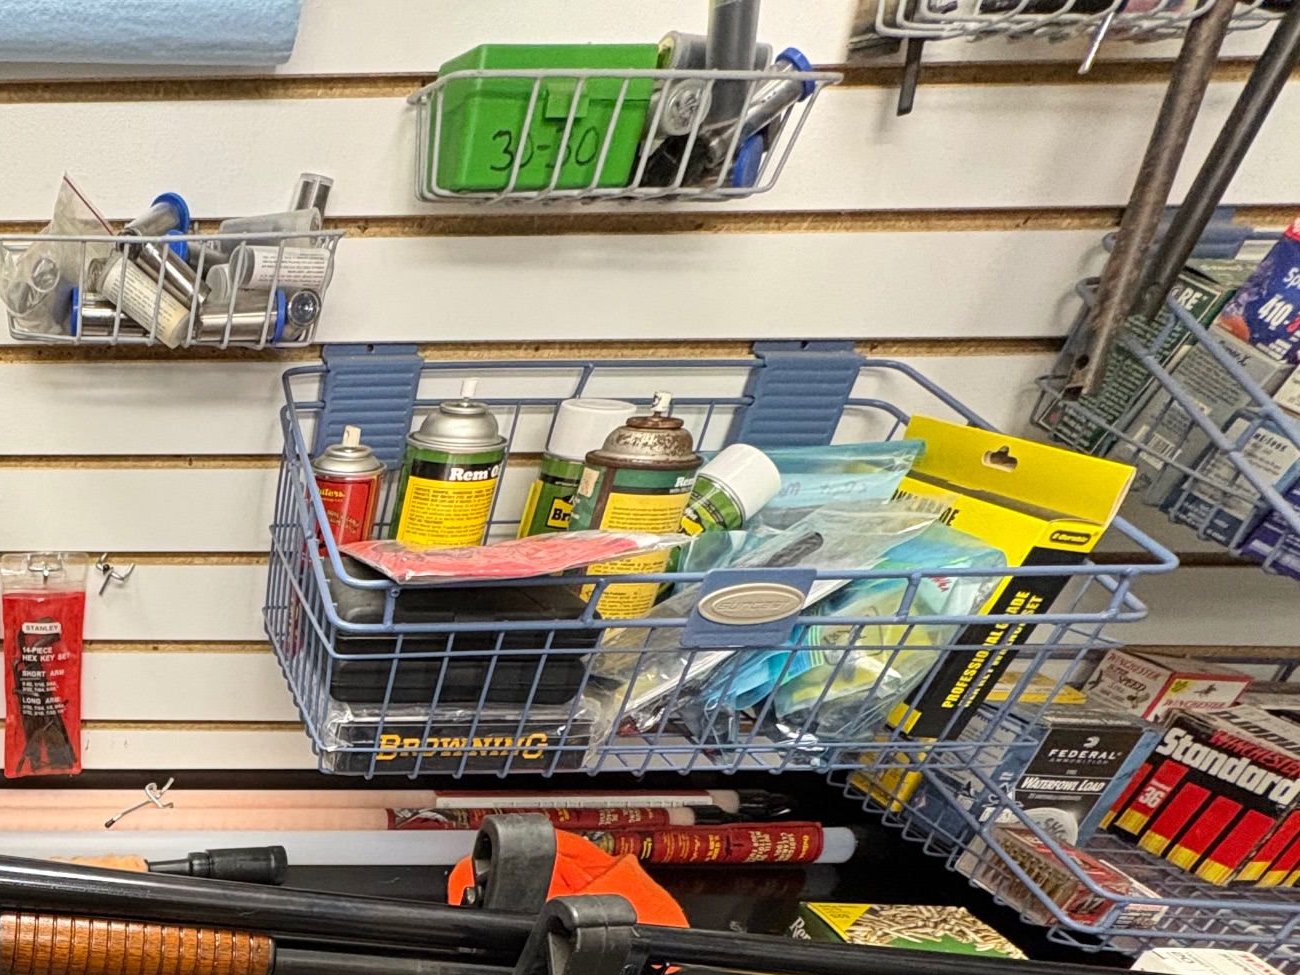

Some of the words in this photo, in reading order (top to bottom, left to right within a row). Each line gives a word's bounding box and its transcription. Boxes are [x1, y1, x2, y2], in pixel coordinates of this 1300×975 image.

[448, 467, 489, 481] Rem
[22, 654, 38, 662] HEX
[40, 654, 56, 662] KEY
[57, 653, 70, 661] SET
[22, 670, 46, 678] SHORT
[50, 669, 65, 677] ARM
[22, 697, 41, 705] LONG
[376, 732, 549, 762] BROWNING
[1048, 749, 1116, 760] FEDERAL
[1155, 727, 1300, 806] Standard
[1021, 776, 1078, 791] WATERFOWL
[1077, 779, 1106, 792] LOAD
[1138, 786, 1166, 808] 36
